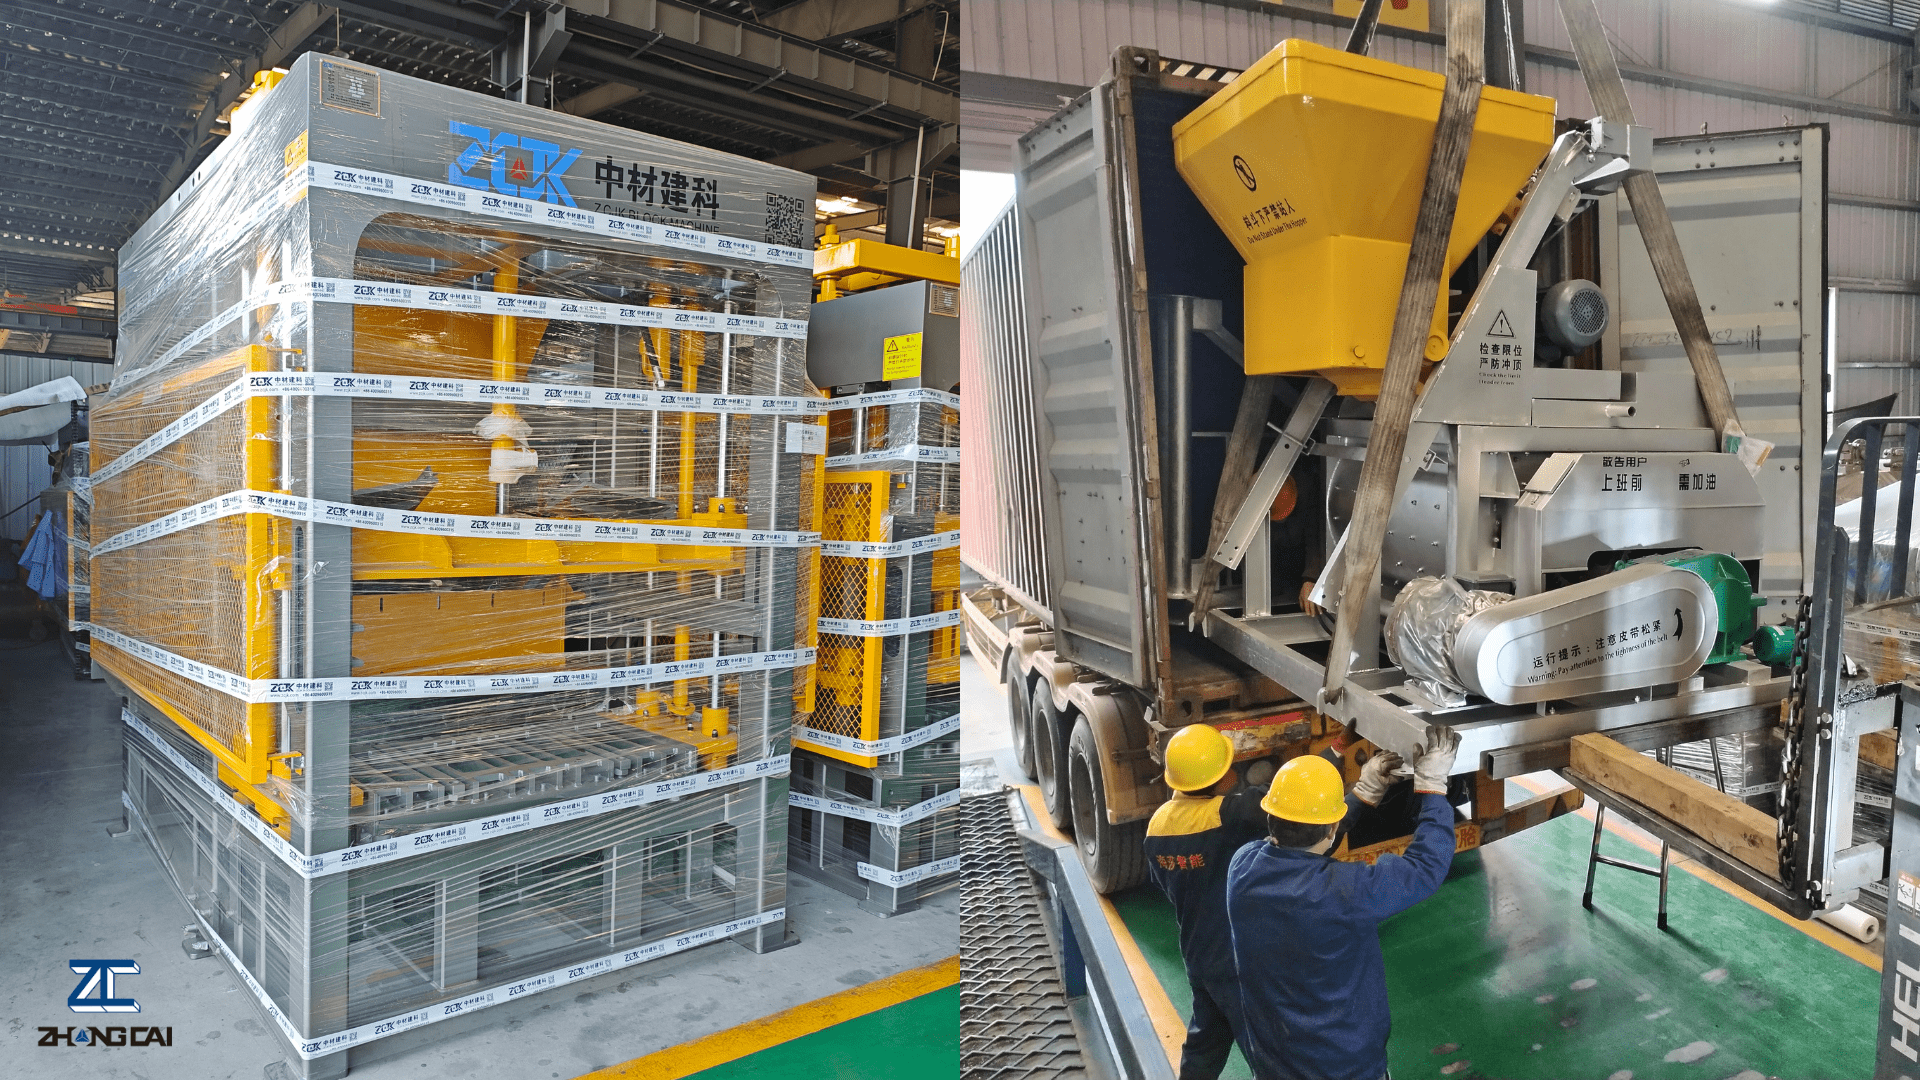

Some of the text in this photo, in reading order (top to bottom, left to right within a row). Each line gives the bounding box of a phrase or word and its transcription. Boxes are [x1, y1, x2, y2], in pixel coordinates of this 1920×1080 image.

[358, 173, 383, 185] 中材建科
[433, 187, 456, 198] 中材建科
[595, 155, 720, 220] 中材建科
[1242, 198, 1296, 231] 料斗下严禁站人
[377, 286, 401, 295] 中材建科
[1479, 342, 1522, 357] 检查限位
[1479, 357, 1522, 371] 严防冲顶
[357, 378, 382, 386] 中材建科
[1602, 456, 1647, 468] 敬告用户
[1601, 473, 1717, 492] 上班前 需加油
[268, 497, 296, 507] 中材建科
[350, 508, 374, 518] 中材建科
[422, 516, 446, 525] 中材建科
[1527, 669, 1557, 684] Warning:
[1558, 666, 1569, 675] Pay
[1569, 657, 1597, 671] attention
[1597, 655, 1604, 663] to
[1604, 651, 1615, 660] the
[1615, 644, 1640, 658] tightness
[1647, 637, 1657, 646] the
[1657, 633, 1668, 643] belt
[296, 682, 322, 690] 中材建科
[374, 680, 398, 688] 中材建科
